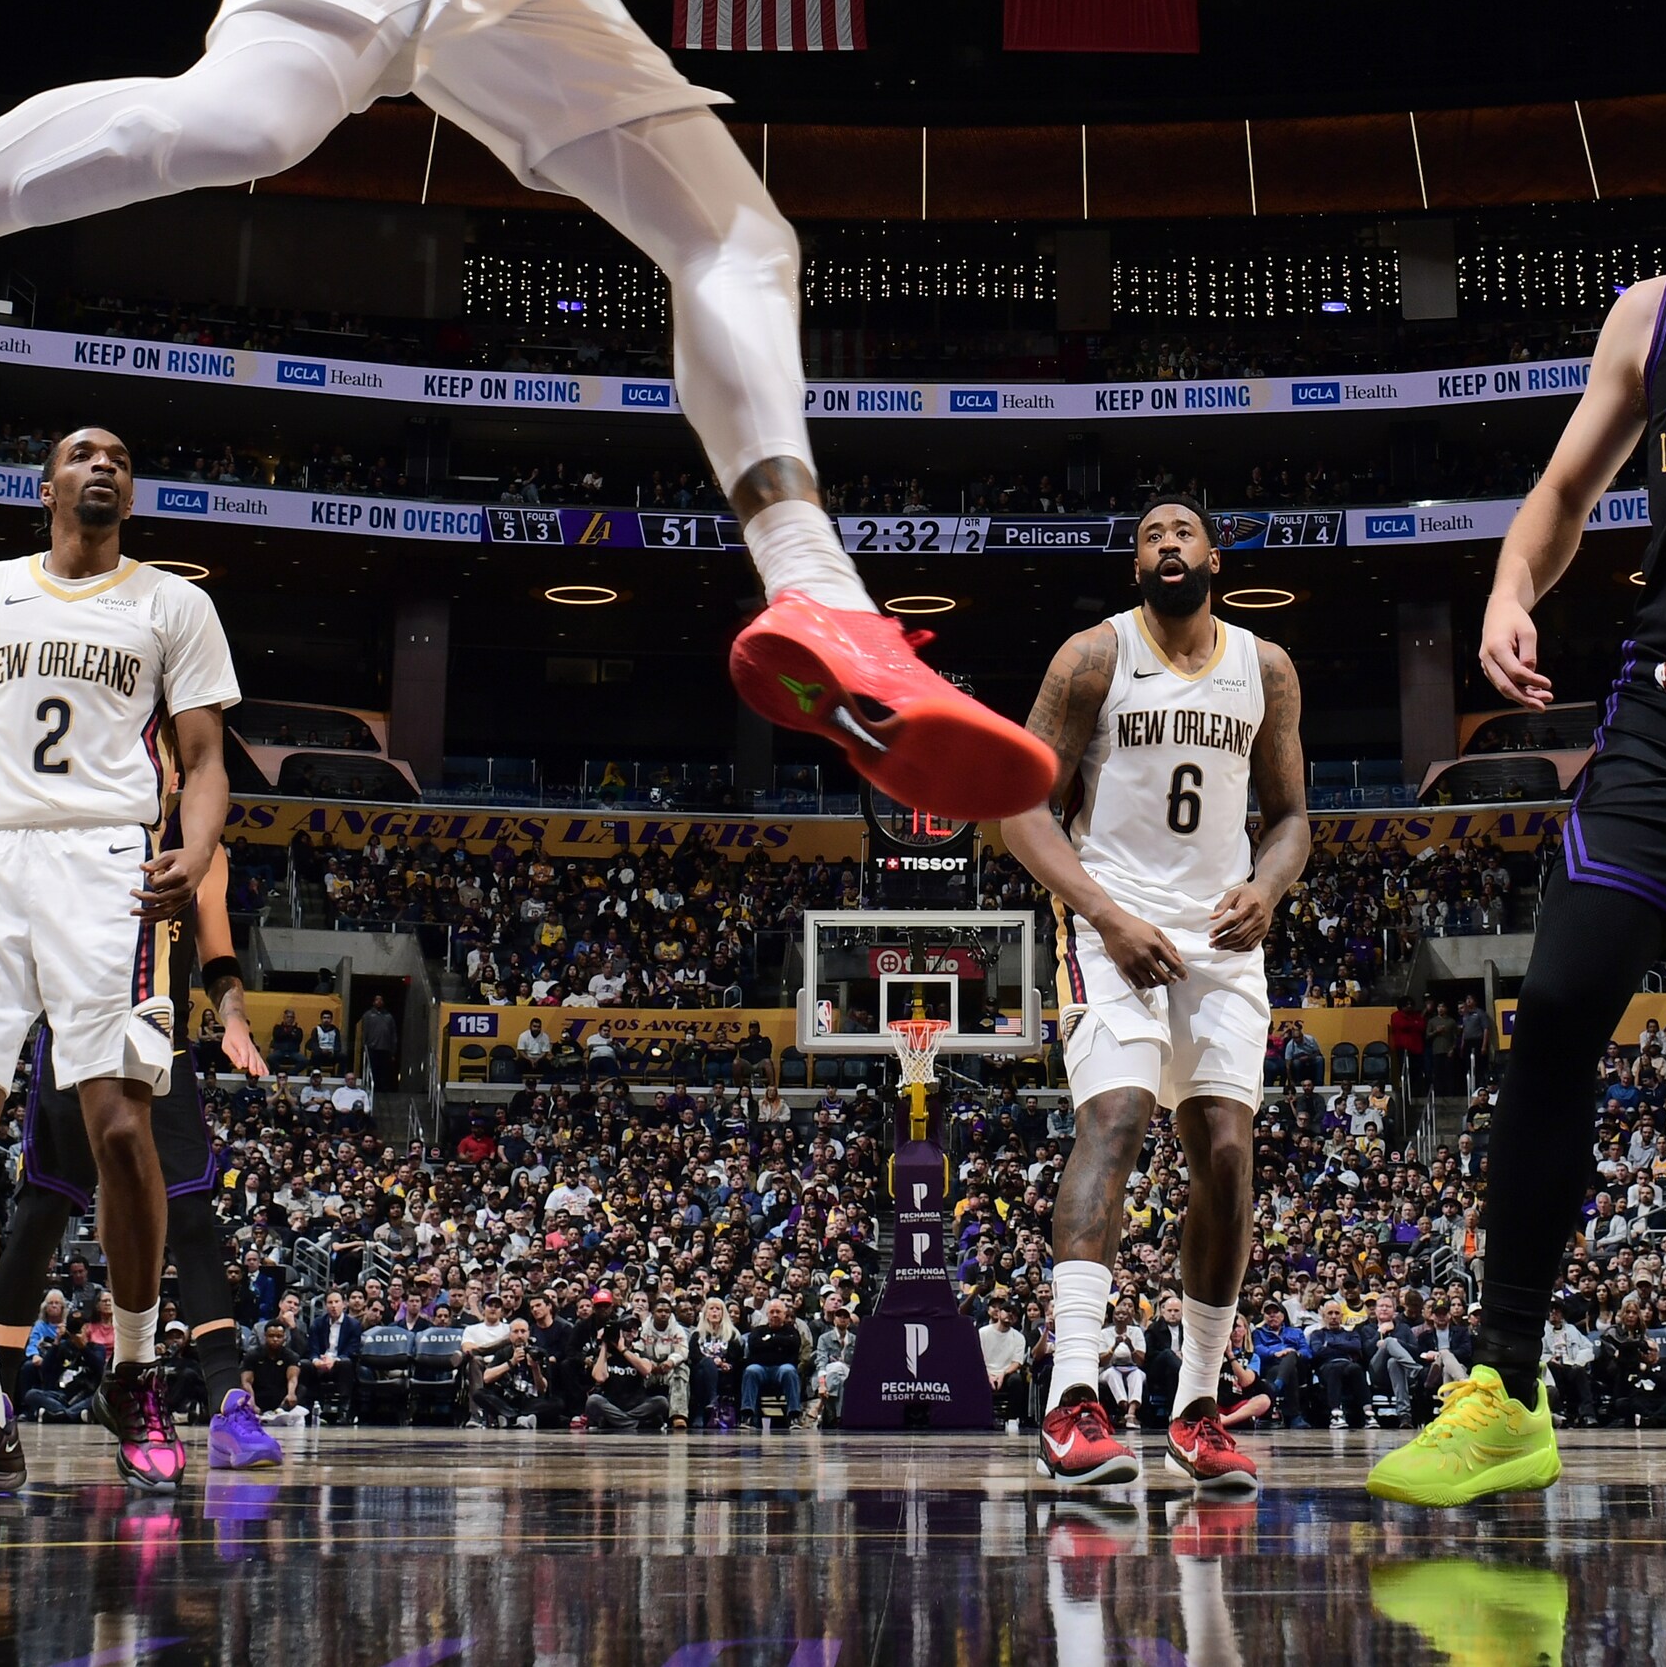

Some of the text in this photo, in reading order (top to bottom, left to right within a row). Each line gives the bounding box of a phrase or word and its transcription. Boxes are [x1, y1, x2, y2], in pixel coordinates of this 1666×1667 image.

[74, 340, 235, 378] KEEP ON RISING
[497, 512, 515, 522] TOL
[527, 512, 555, 522] FOULS
[964, 518, 980, 527] QTR
[1273, 515, 1303, 525] FOULS
[1314, 515, 1330, 524] TOL
[1371, 513, 1474, 534] UCLA Health
[503, 523, 515, 539] 5
[537, 525, 548, 540] 3
[662, 518, 697, 546] 51
[857, 520, 940, 552] 2:32
[1005, 526, 1091, 545] Pelicans
[1281, 526, 1293, 544] 3
[1316, 525, 1329, 544] 4
[965, 530, 980, 552] 2
[97, 598, 137, 607] NEWAGE
[38, 640, 141, 698] ORLEANS
[1213, 678, 1247, 687] NEWAGE
[34, 697, 71, 774] 2
[1117, 709, 1253, 758] NEW ORLEANS
[1167, 763, 1204, 836] 6
[295, 806, 792, 848] ANGELES LAKERS
[901, 858, 967, 870] TISSOT
[457, 1015, 490, 1033] 115
[604, 1018, 741, 1033] LOS ANGELES
[375, 1334, 407, 1342] DELTA
[429, 1334, 461, 1342] DELTA
[882, 1382, 950, 1393] PECHANGA
